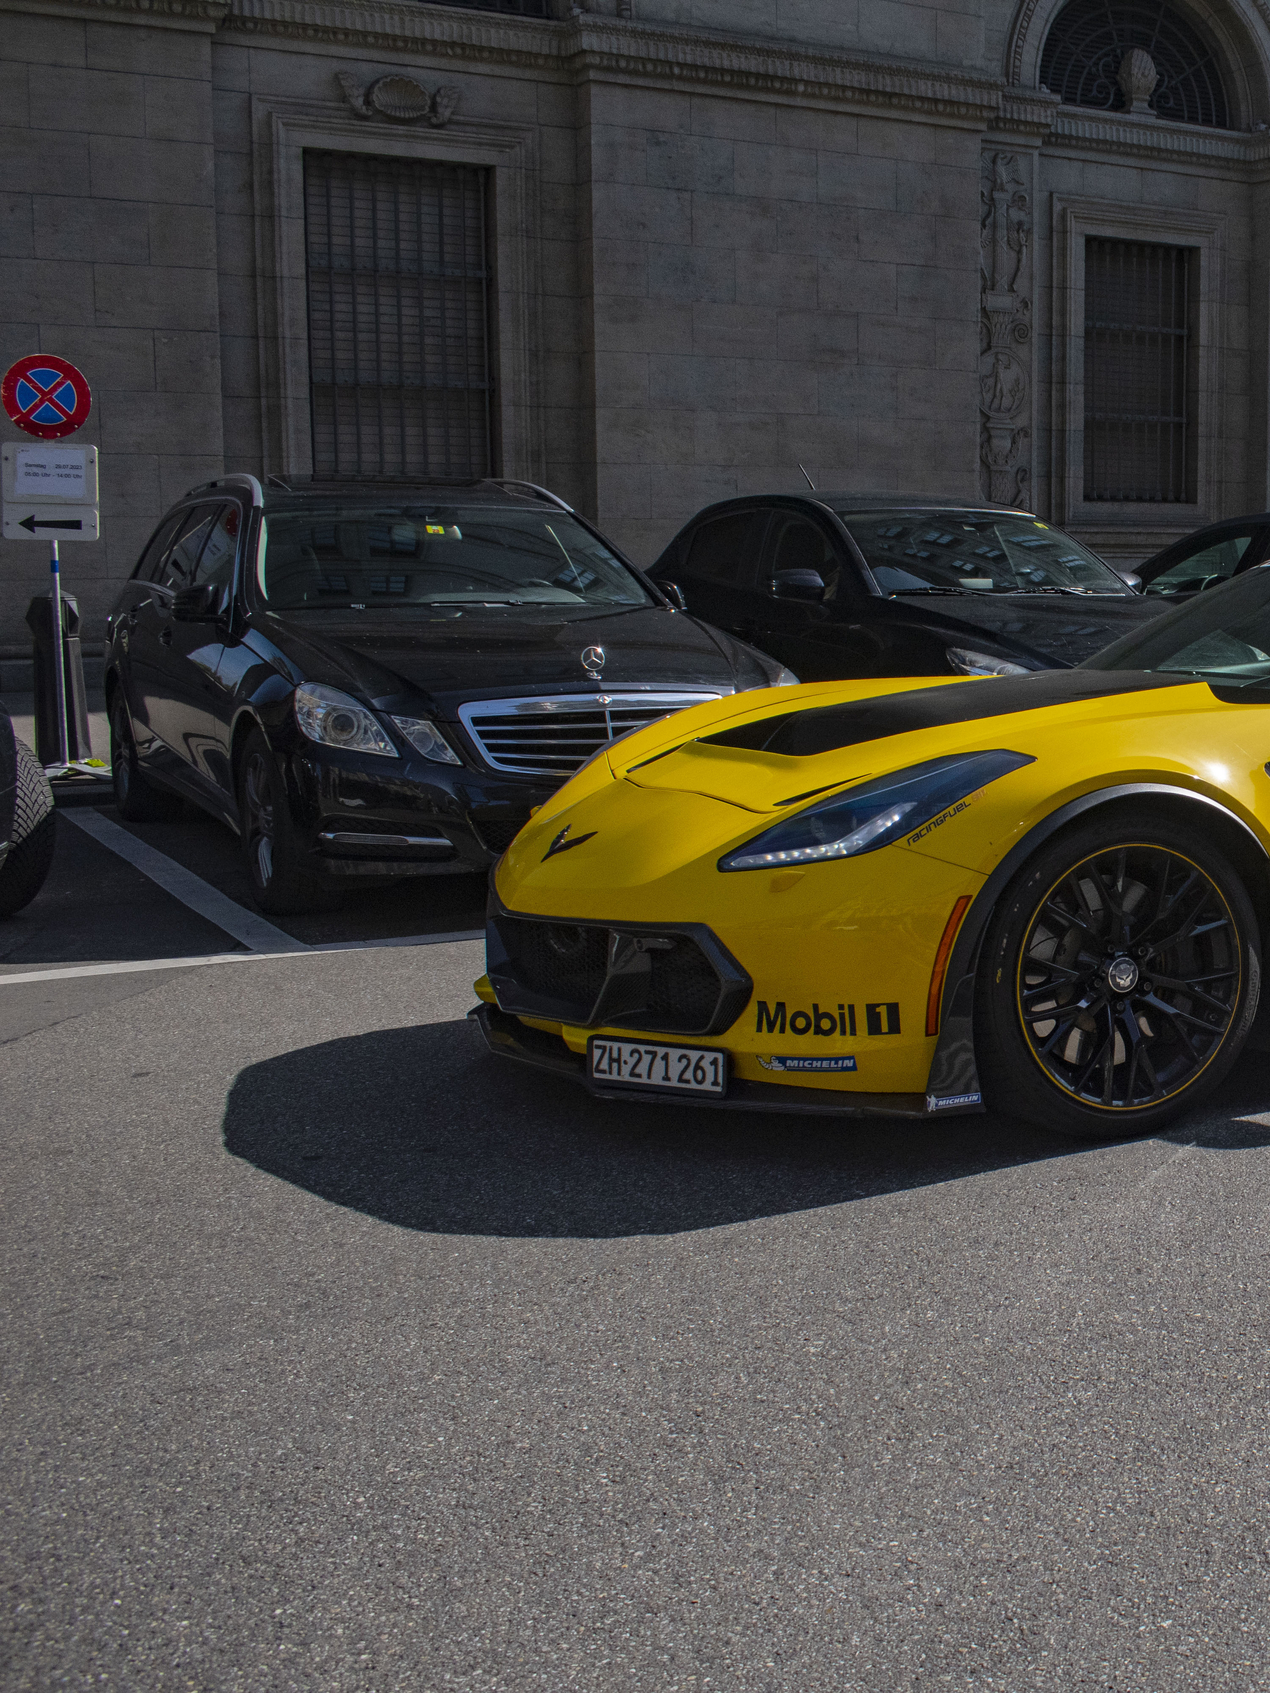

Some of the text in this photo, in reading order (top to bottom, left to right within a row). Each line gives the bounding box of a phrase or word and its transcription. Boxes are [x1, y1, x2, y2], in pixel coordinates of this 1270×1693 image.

[756, 1000, 857, 1036] Mobil
[785, 1059, 854, 1068] MICHELIN
[938, 1095, 979, 1106] MICHELIN
